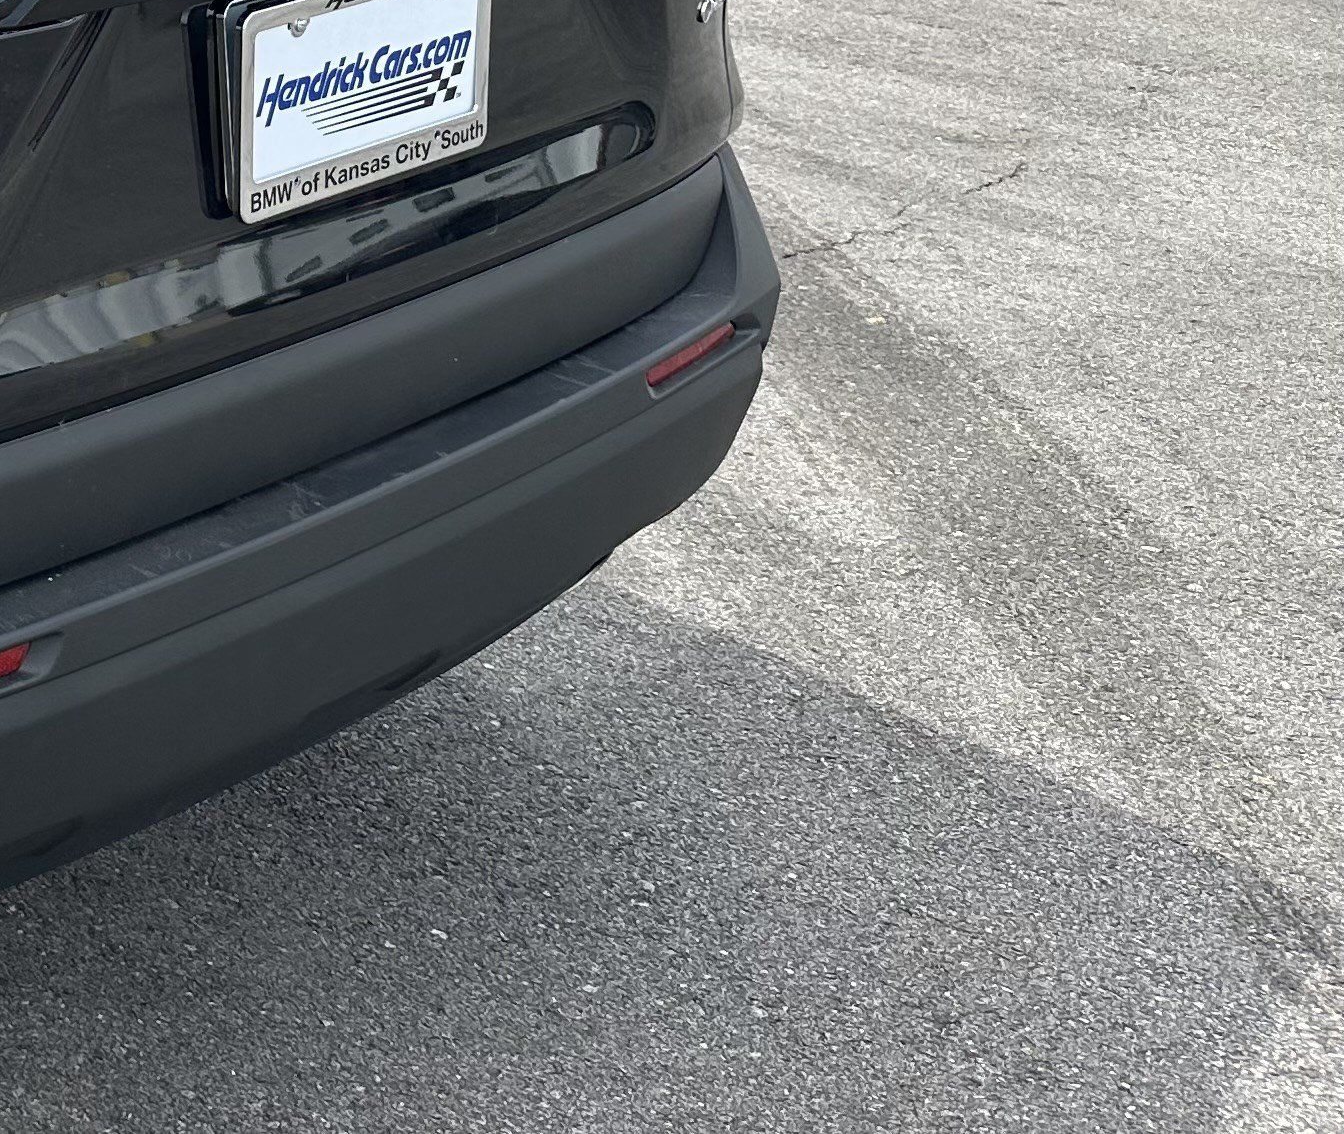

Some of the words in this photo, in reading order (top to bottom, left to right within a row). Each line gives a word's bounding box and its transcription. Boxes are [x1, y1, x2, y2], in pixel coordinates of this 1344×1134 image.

[300, 171, 321, 196] of
[324, 154, 390, 189] Kansas
[395, 140, 432, 162] City
[440, 119, 484, 149] South
